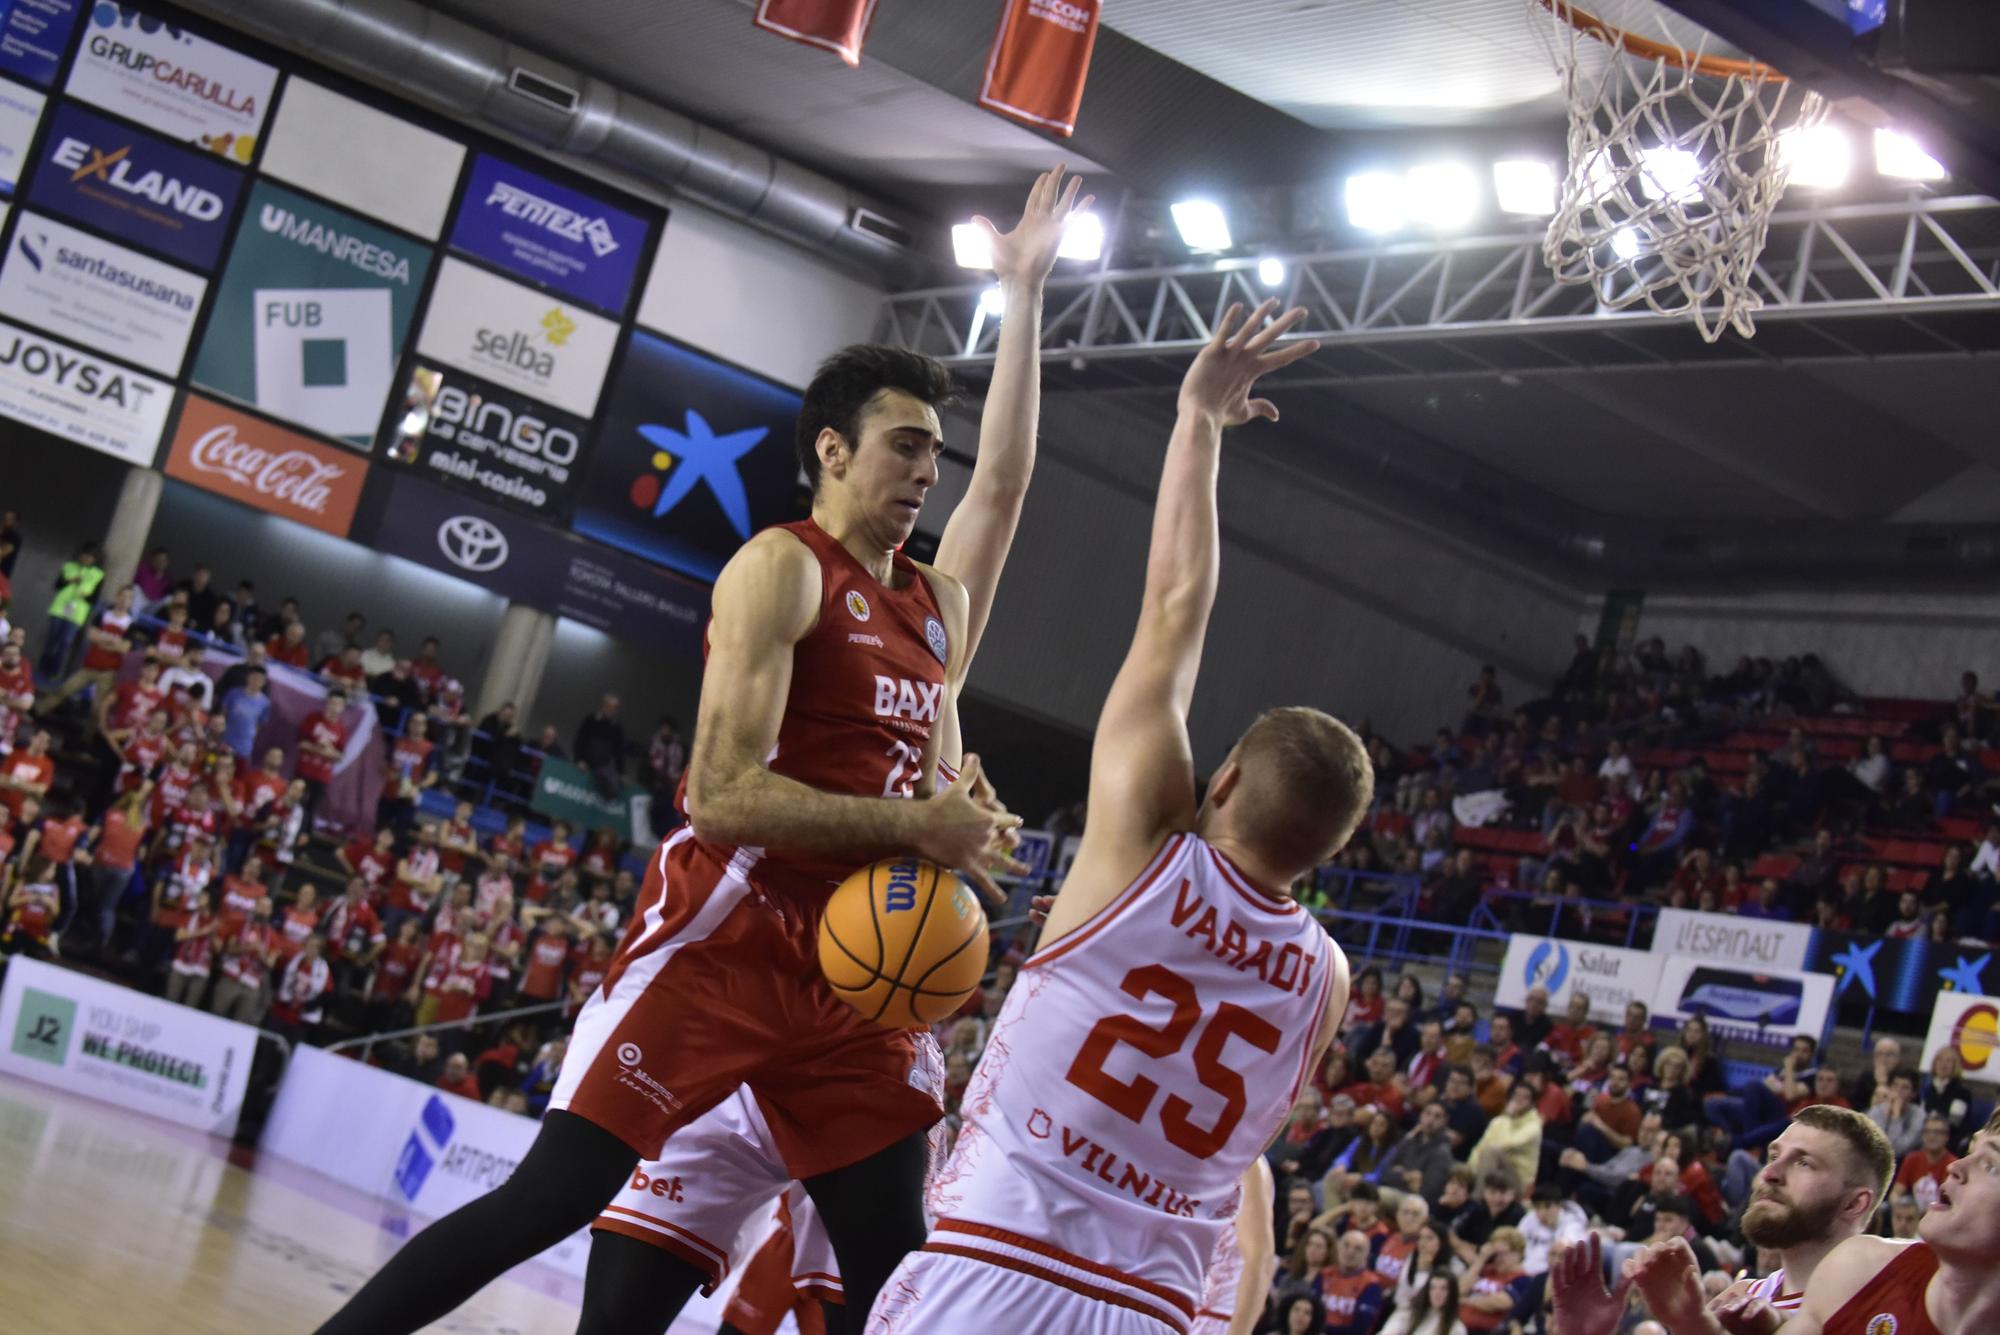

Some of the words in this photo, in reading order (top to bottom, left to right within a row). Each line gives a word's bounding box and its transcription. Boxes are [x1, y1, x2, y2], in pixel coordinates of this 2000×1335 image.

[89, 35, 255, 116] GRUPCARULLA
[52, 137, 223, 221] EXLAND
[260, 202, 410, 285] UMANRESA
[56, 246, 194, 311] santasusana
[266, 302, 322, 327] FUB
[0, 337, 155, 413] JOYSAT
[472, 326, 555, 379] selba
[430, 450, 546, 506] mini-casino
[885, 859, 918, 915] Wil
[1576, 948, 1622, 978] Salut
[1675, 918, 1786, 963] L'ESPINALT
[27, 1015, 60, 1045] J2
[1065, 963, 1283, 1160] 25
[1060, 1126, 1201, 1218] VILNIUS
